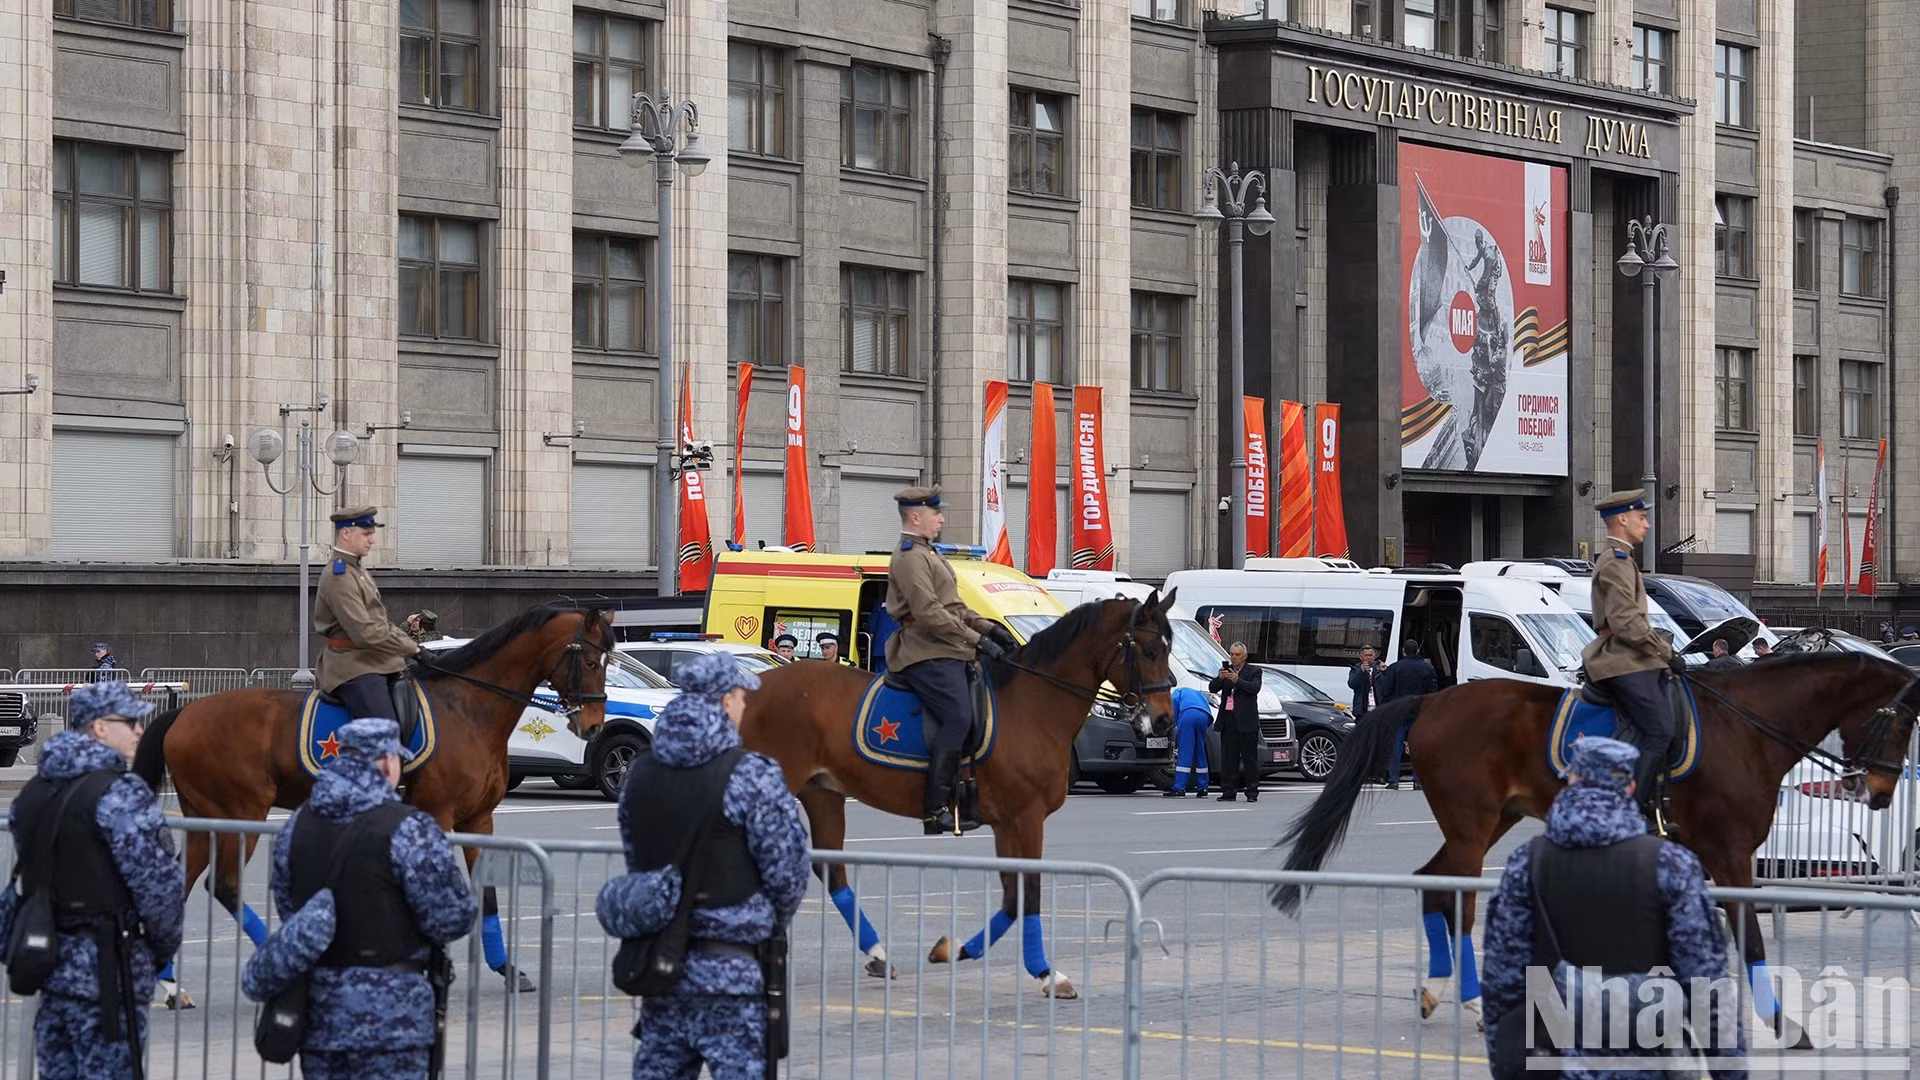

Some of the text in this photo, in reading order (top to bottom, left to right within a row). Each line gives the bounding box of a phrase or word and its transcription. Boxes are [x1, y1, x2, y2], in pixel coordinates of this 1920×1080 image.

[1308, 66, 1651, 158] ГОСУДАРСТВЕННАЯ ДУМА
[1452, 308, 1474, 336] МАЯ
[788, 384, 801, 431] 9
[1518, 394, 1559, 416] ГОРДИМСЯ
[1322, 418, 1336, 459] 9
[1518, 416, 1555, 439] ПОБЕДОЙ!
[1079, 412, 1102, 530] ГОРДИМСЯ!
[1247, 433, 1266, 517] ПОБЕДА!
